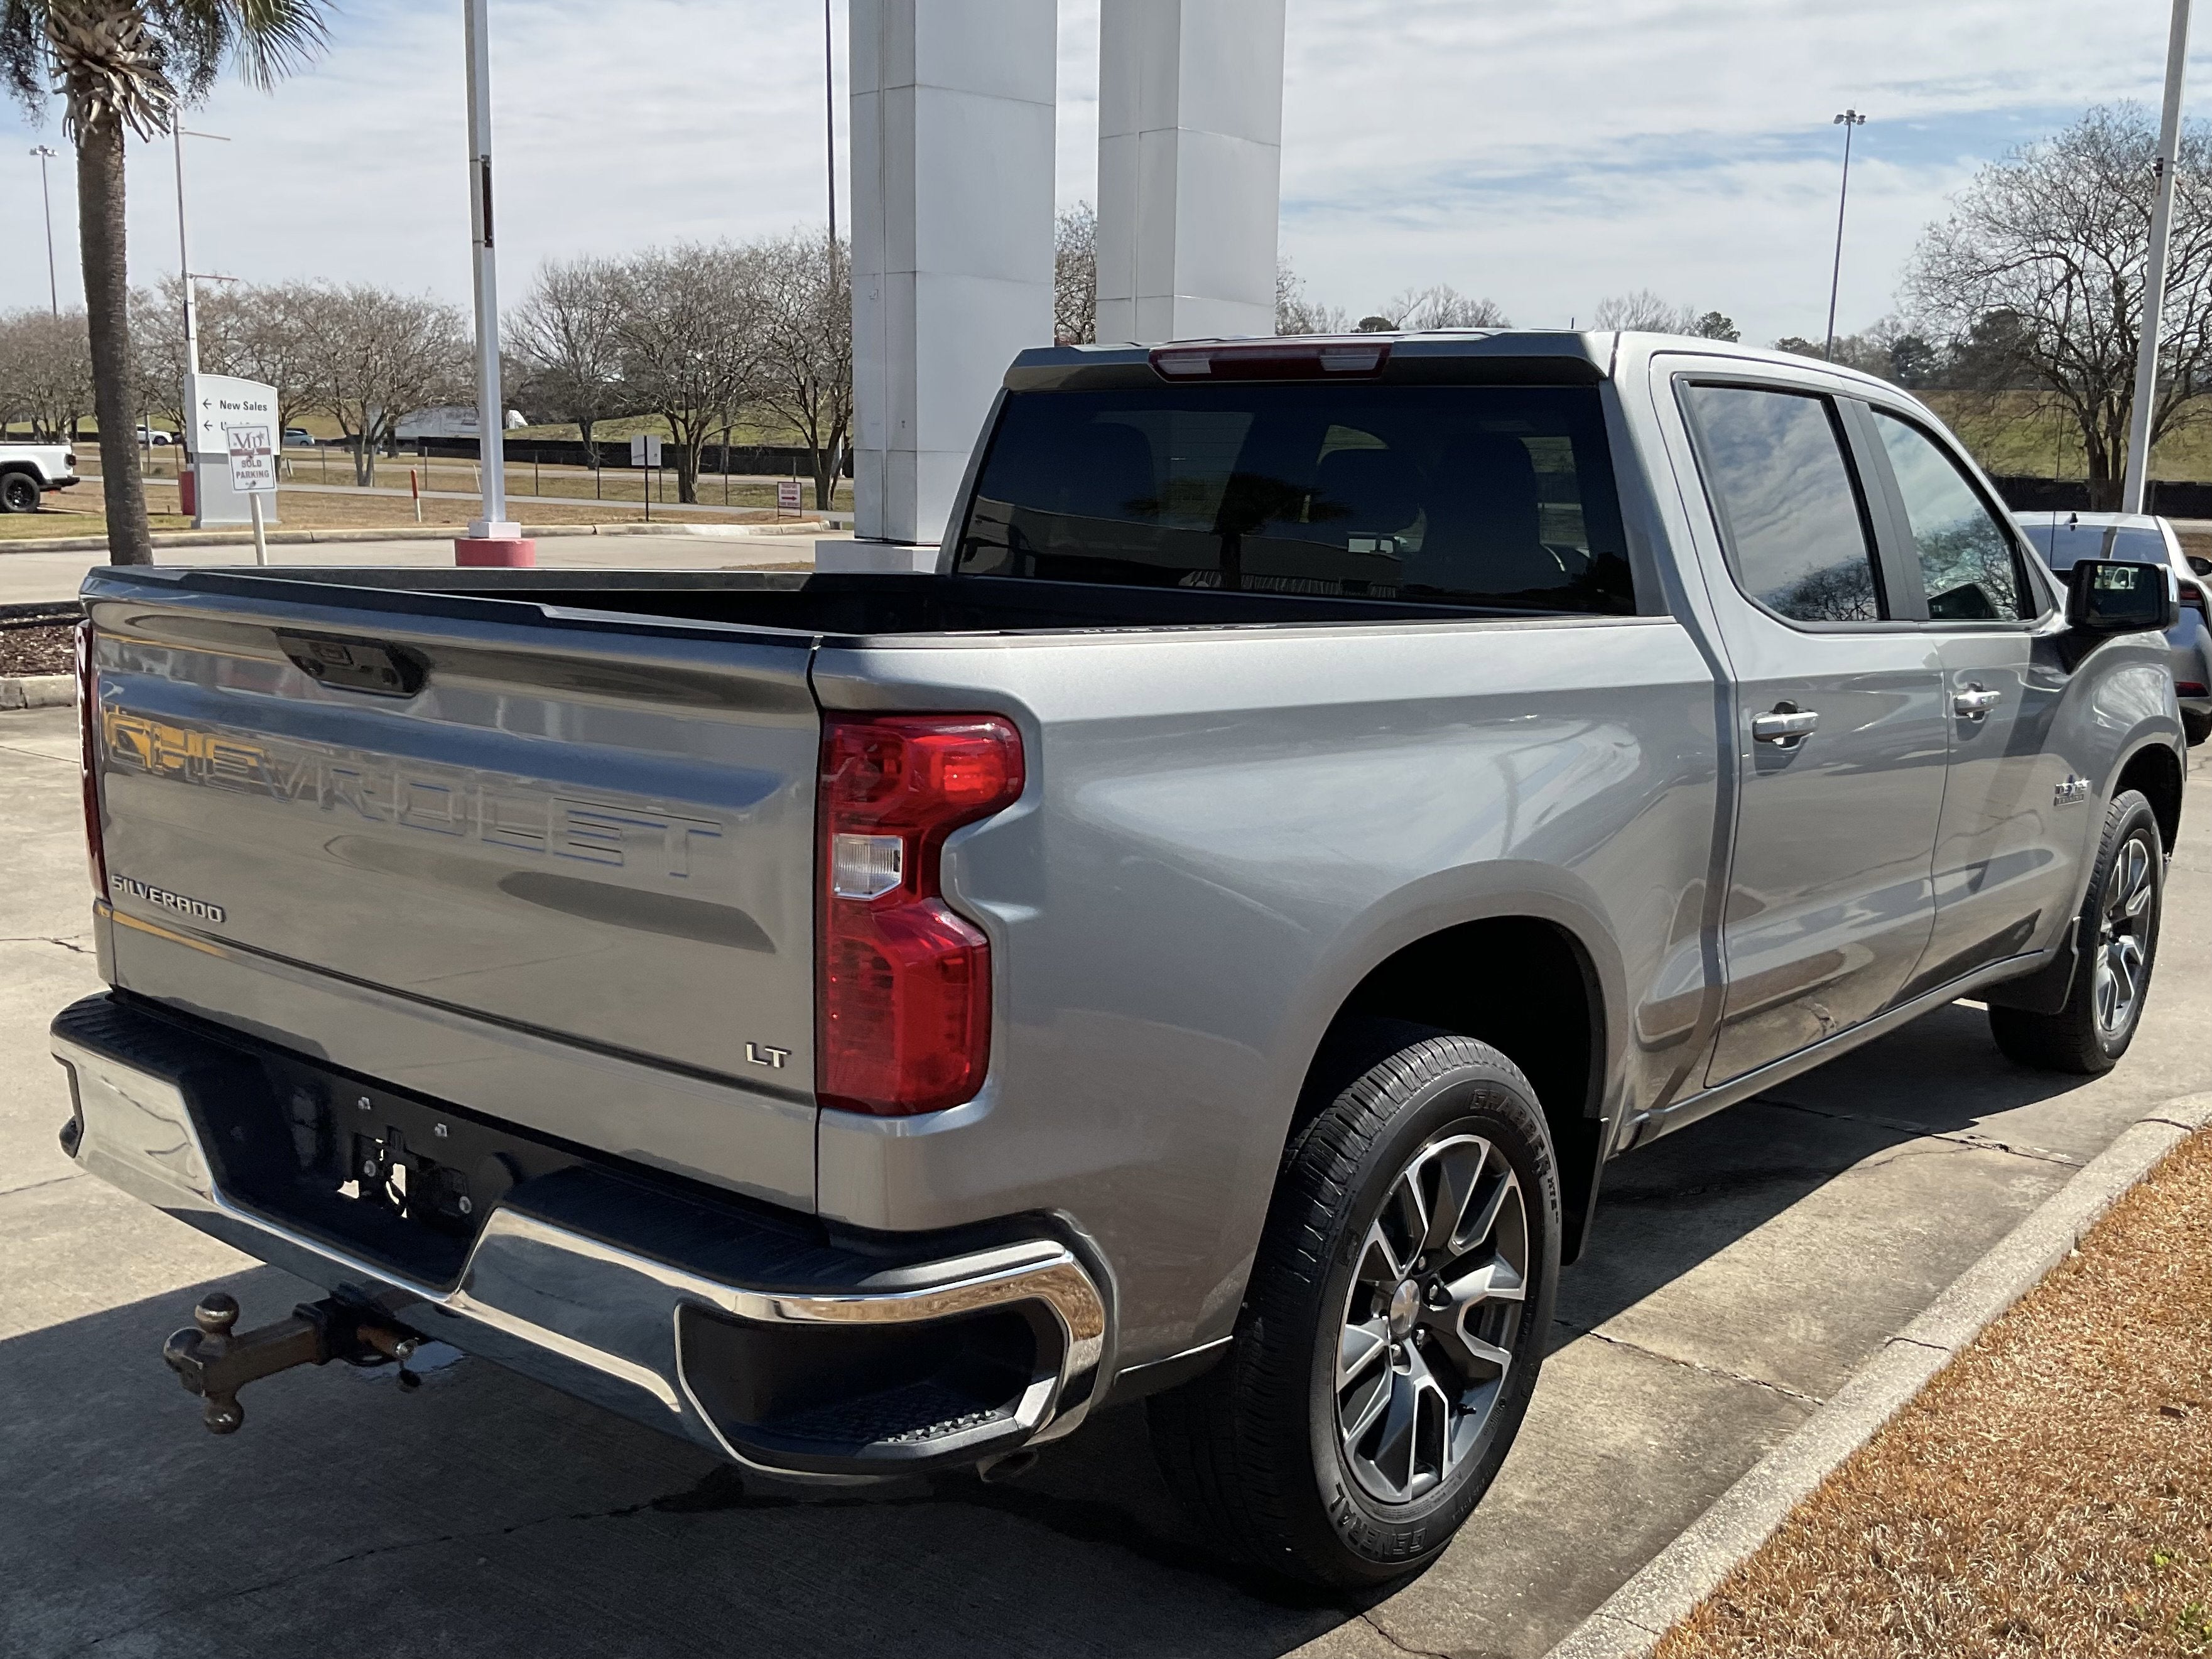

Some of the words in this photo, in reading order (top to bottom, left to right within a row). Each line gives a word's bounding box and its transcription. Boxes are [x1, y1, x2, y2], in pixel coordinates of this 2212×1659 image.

[220, 400, 240, 410] New
[243, 401, 268, 411] Sales
[236, 470, 269, 478] PARKING
[106, 713, 724, 879] CHEVROLET
[111, 874, 225, 922] SILVERADO
[745, 1042, 791, 1068] LT
[1328, 1482, 1427, 1557] GENERAL
